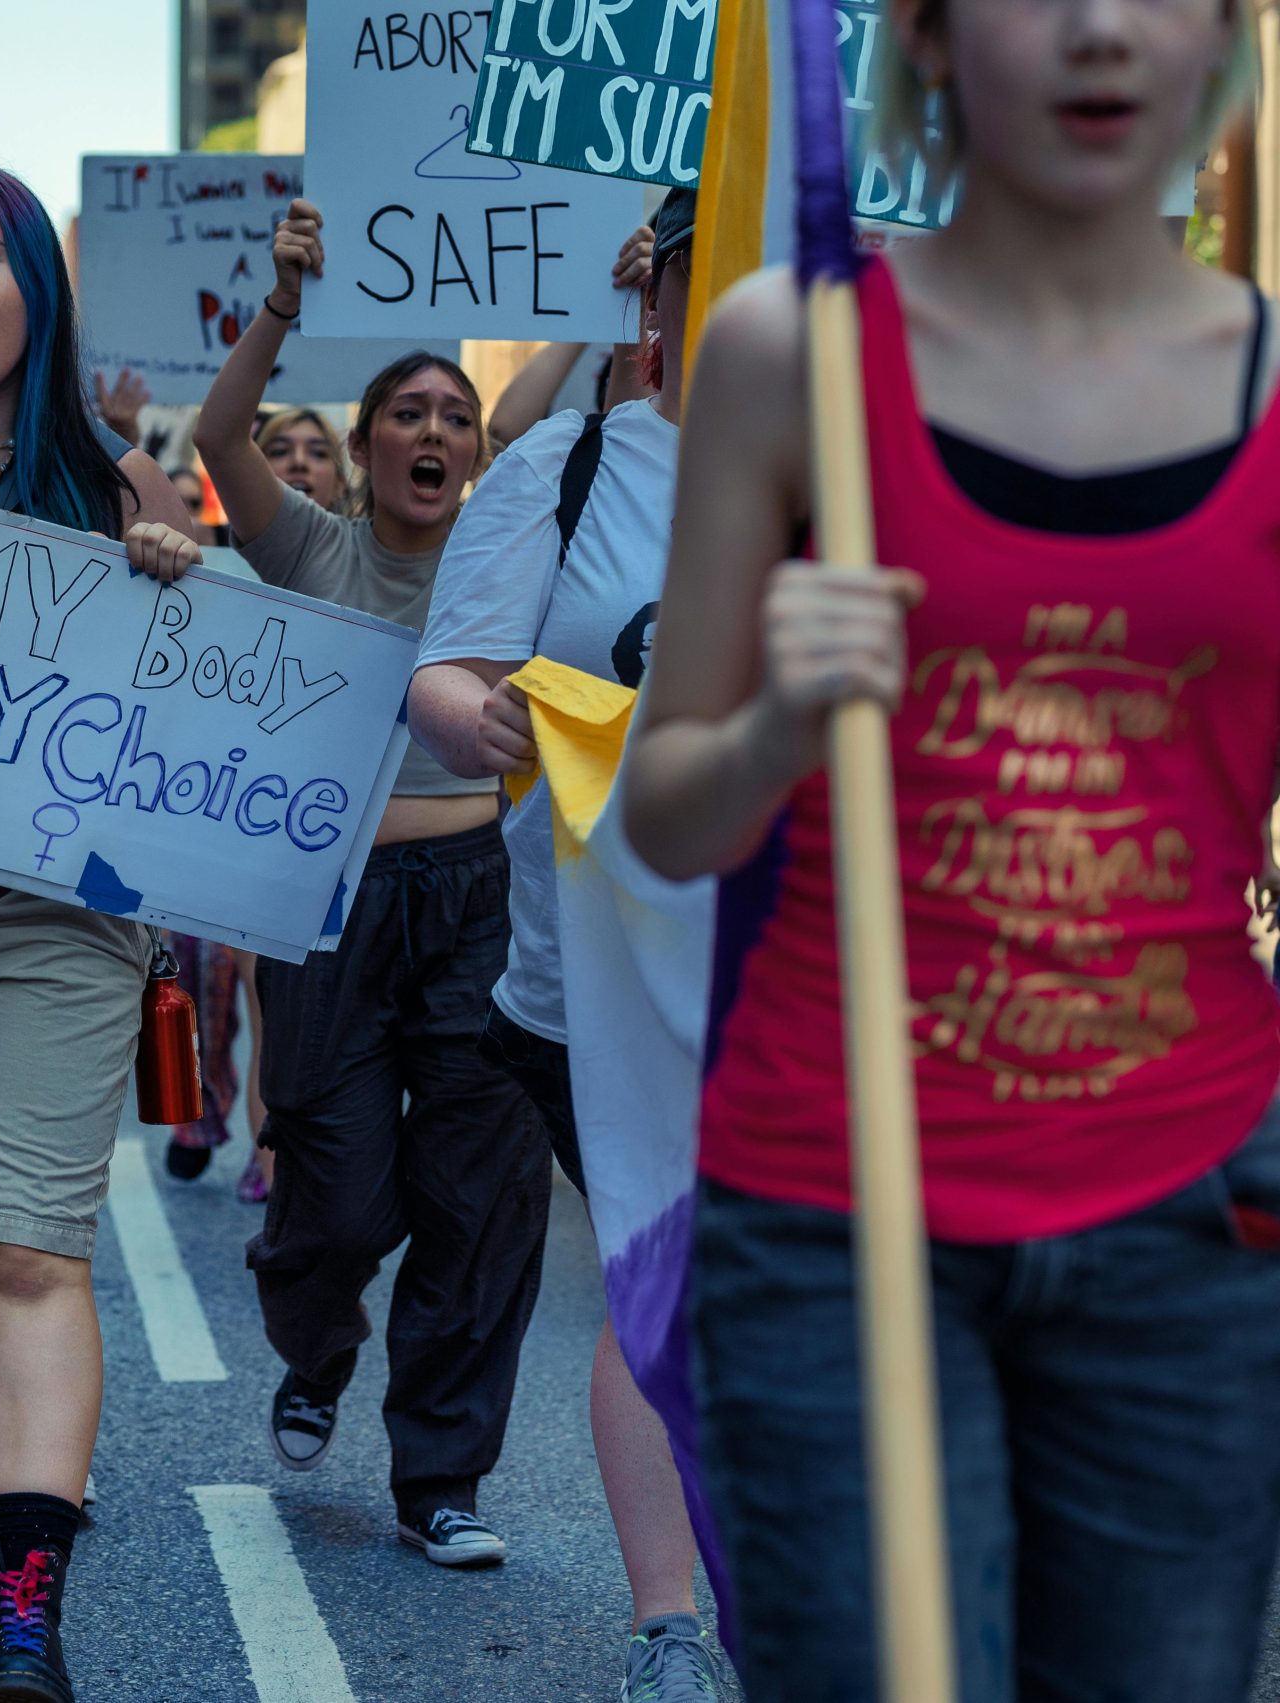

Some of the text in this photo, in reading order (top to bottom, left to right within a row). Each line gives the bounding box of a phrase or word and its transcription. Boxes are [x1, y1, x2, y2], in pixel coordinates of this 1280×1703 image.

[484, 55, 712, 182] I'M SUC
[356, 202, 570, 317] SAFE
[131, 583, 350, 736] Body
[41, 692, 349, 853] Choice
